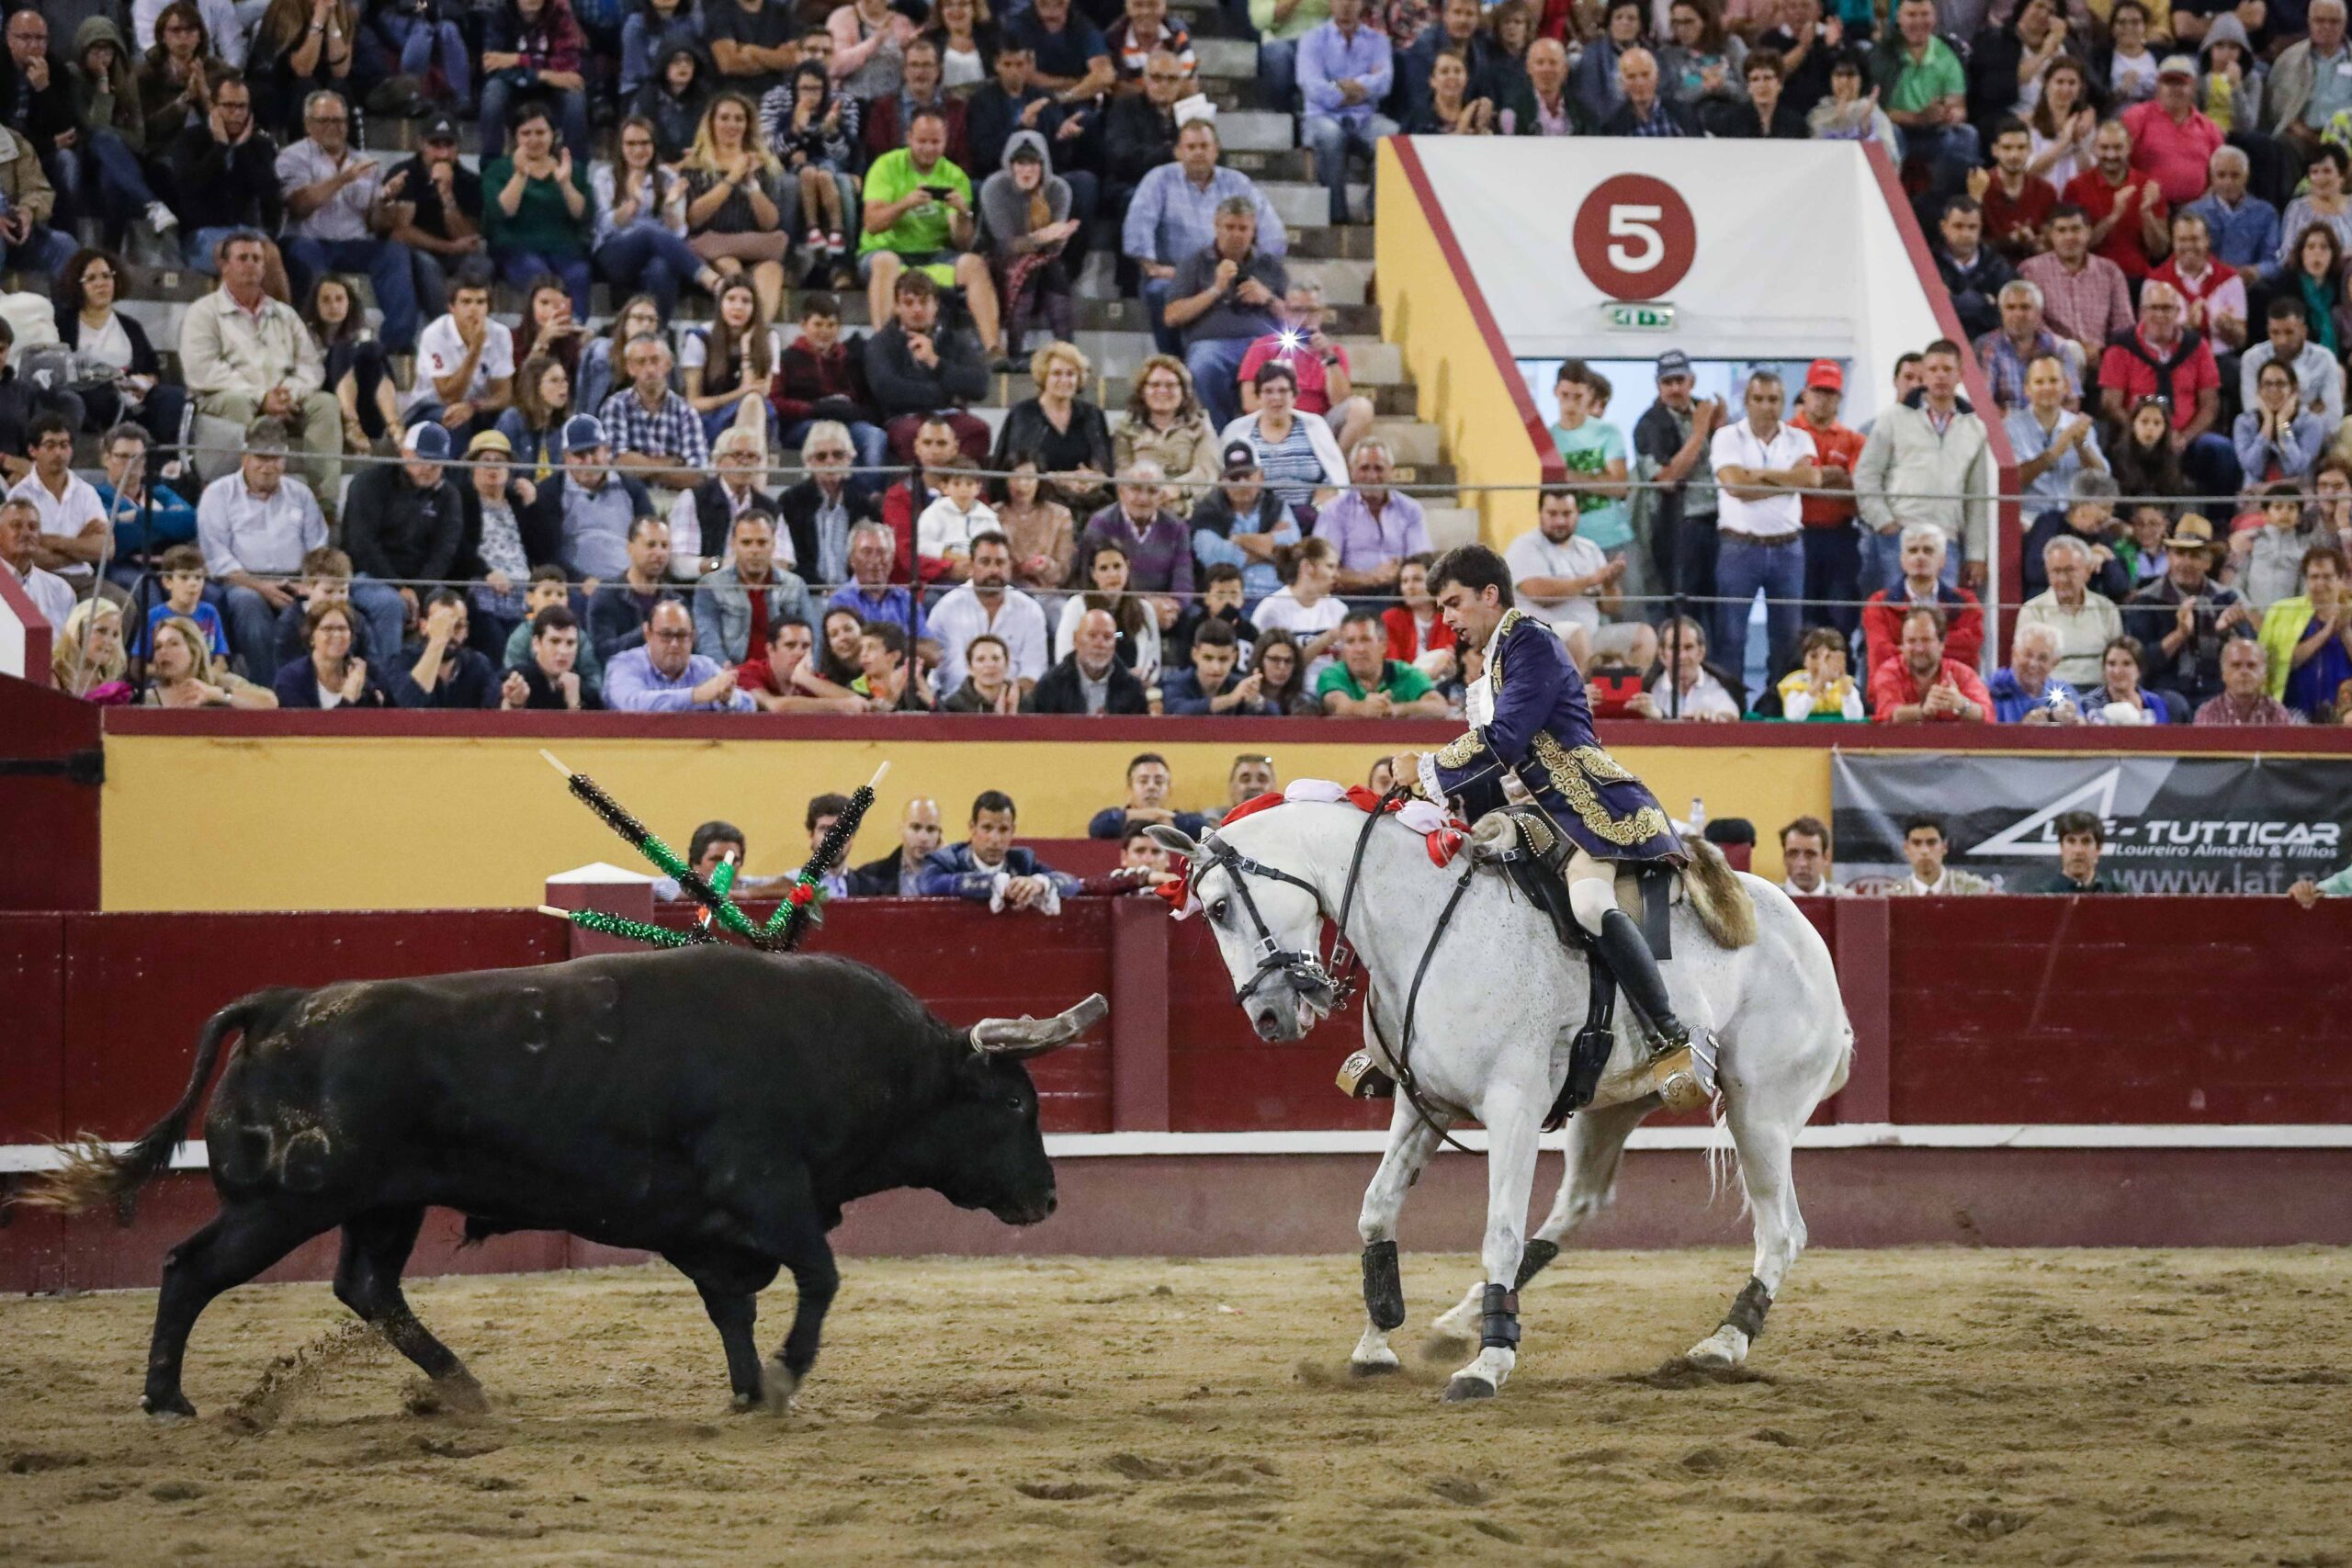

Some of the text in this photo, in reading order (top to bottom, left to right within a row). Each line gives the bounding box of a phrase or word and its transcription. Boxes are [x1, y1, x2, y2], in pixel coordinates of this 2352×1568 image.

[1608, 204, 1665, 274] 5
[2144, 820, 2340, 845] TUTTICAR
[2115, 843, 2338, 858] Loureiro Almeida & Filhos
